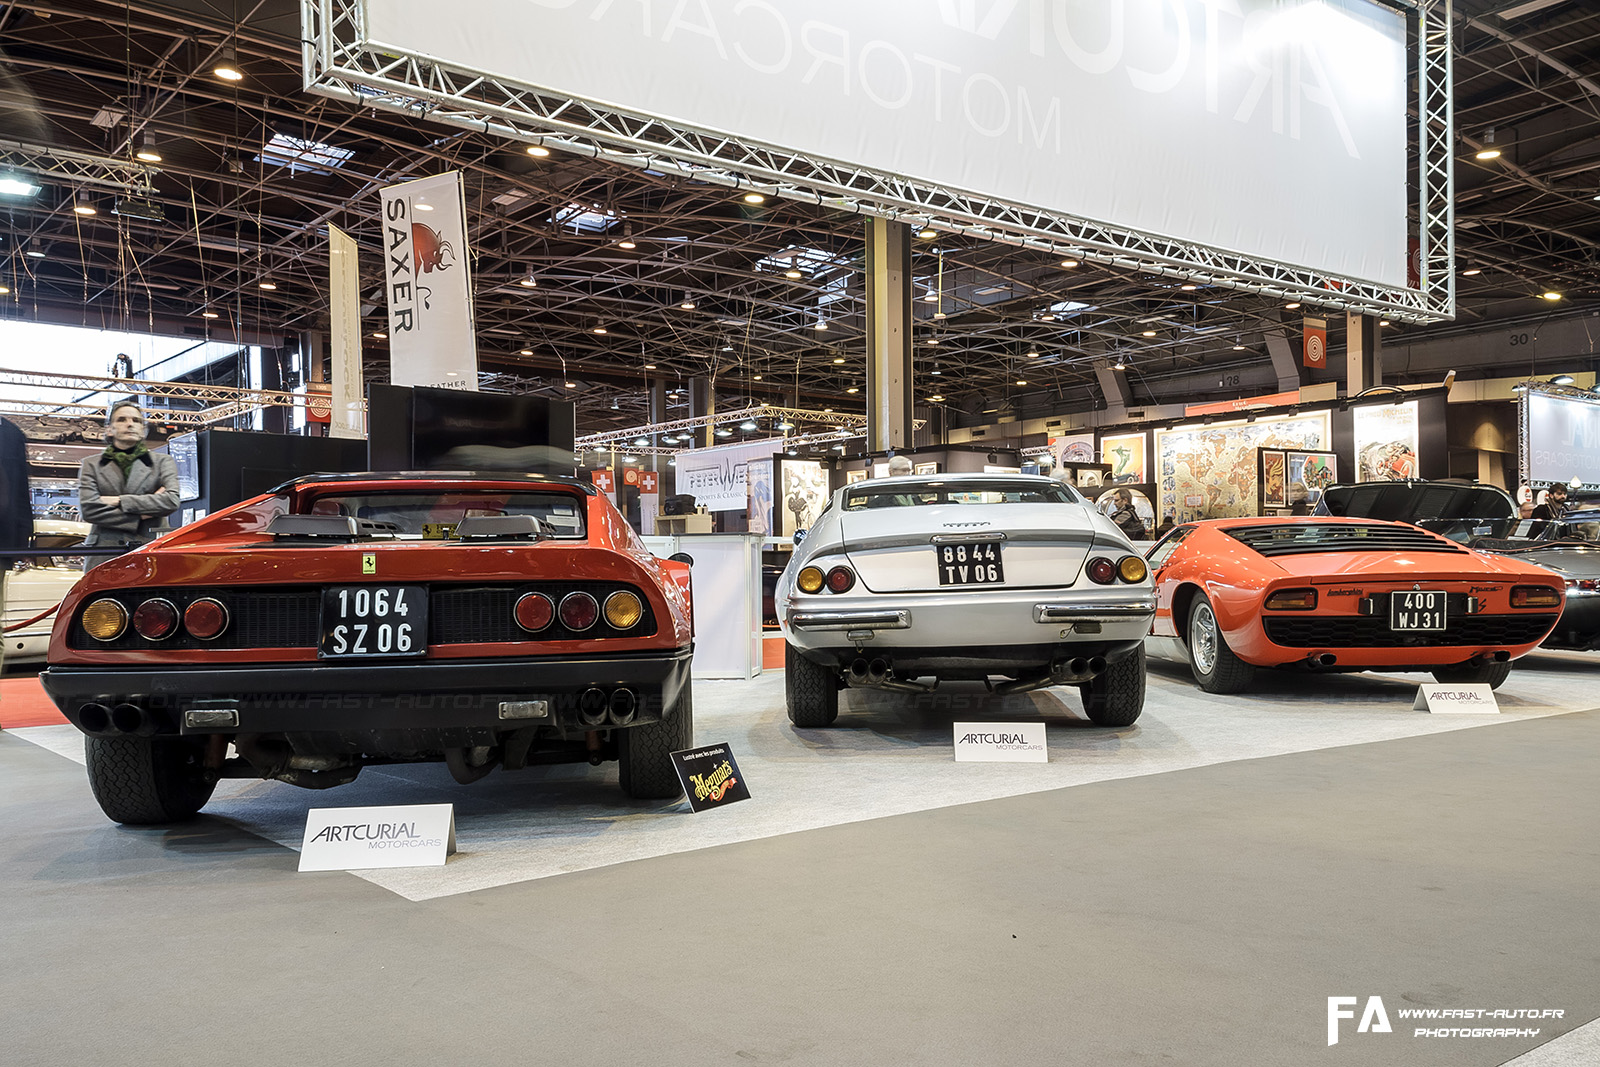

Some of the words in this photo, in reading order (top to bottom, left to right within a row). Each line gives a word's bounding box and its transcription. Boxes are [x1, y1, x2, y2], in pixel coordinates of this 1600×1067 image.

[386, 198, 414, 335] SAXER
[1509, 333, 1529, 346] 30
[424, 380, 466, 390] EATHER
[945, 565, 969, 584] TV
[974, 563, 998, 582] 06
[338, 588, 409, 618] 1064
[1404, 593, 1435, 609] 400
[1399, 612, 1419, 628] WJ
[1423, 612, 1440, 628] 31
[333, 624, 369, 654] SZ
[377, 623, 412, 652] 06
[368, 838, 442, 849] MOTORCARS
